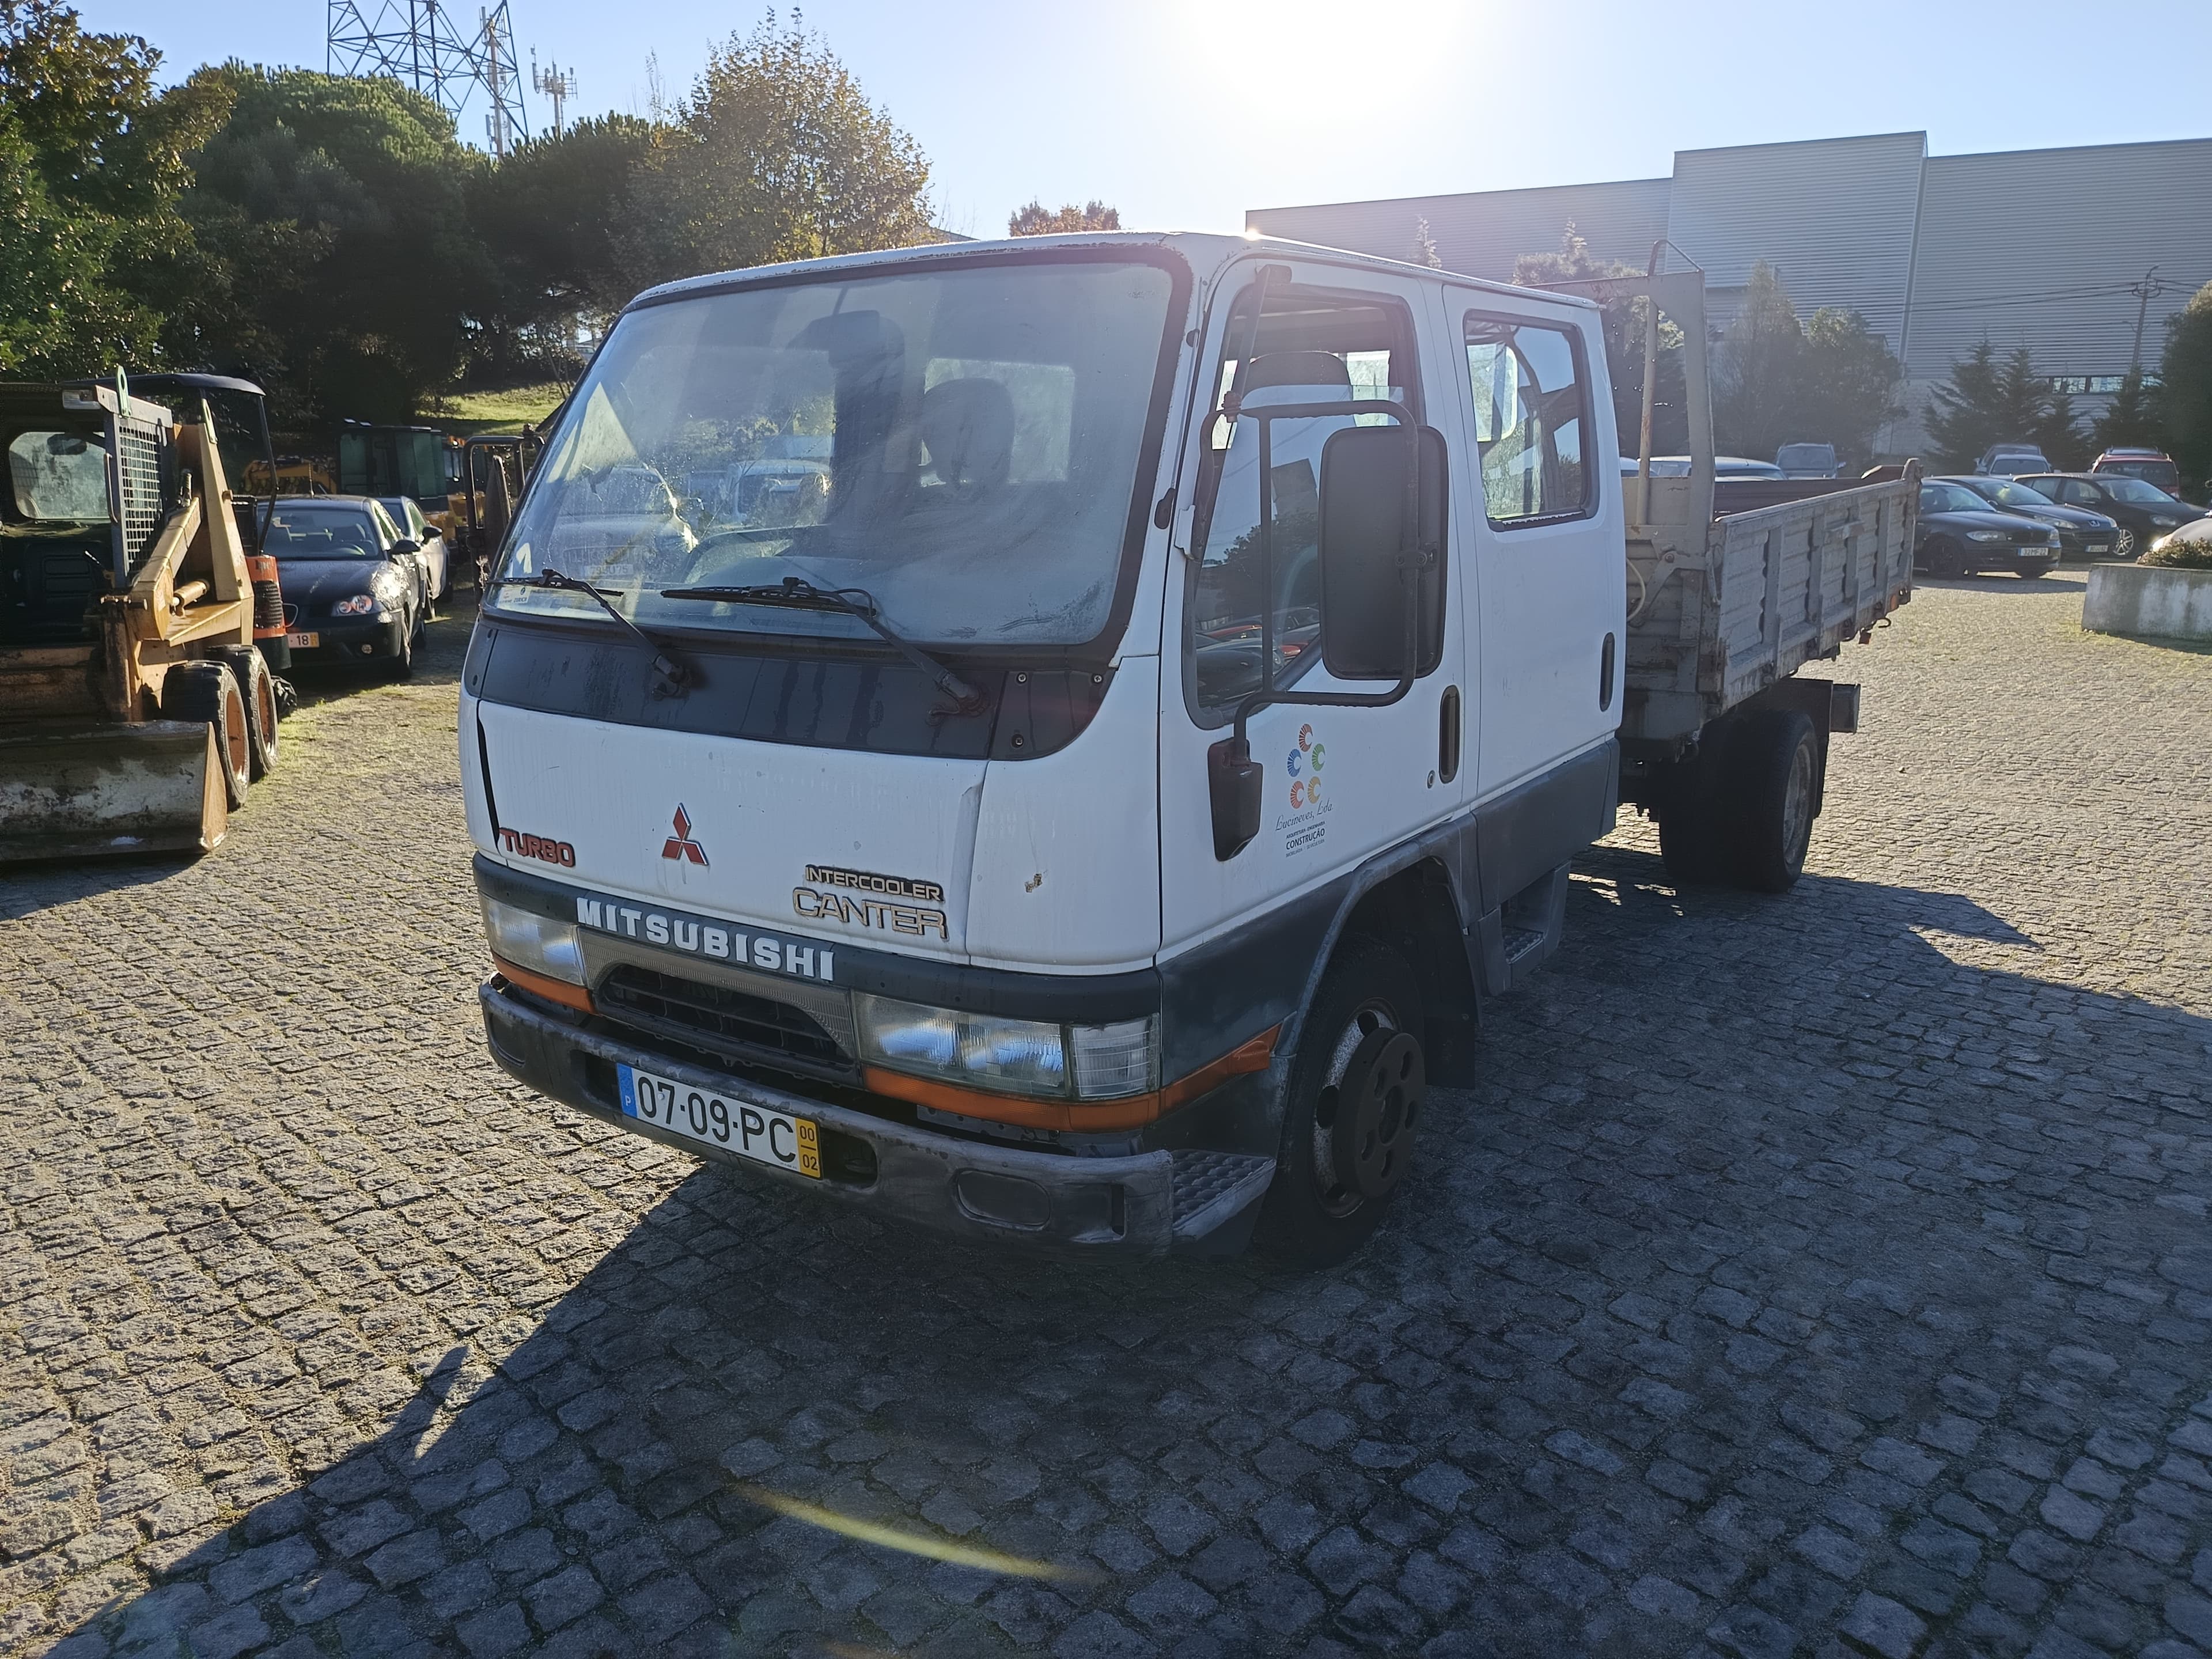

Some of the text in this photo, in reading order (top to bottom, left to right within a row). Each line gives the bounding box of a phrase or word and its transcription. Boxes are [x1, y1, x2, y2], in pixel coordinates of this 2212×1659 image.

[499, 827, 575, 868] TURBO
[1286, 828, 1325, 850] CONSTRUÇÃO
[806, 866, 942, 902] INTERCOOLER
[793, 888, 948, 941] CANTER
[576, 896, 835, 982] MITSUBISHI
[625, 1095, 632, 1107] P
[800, 1125, 815, 1143] 00
[802, 1154, 819, 1171] 02
